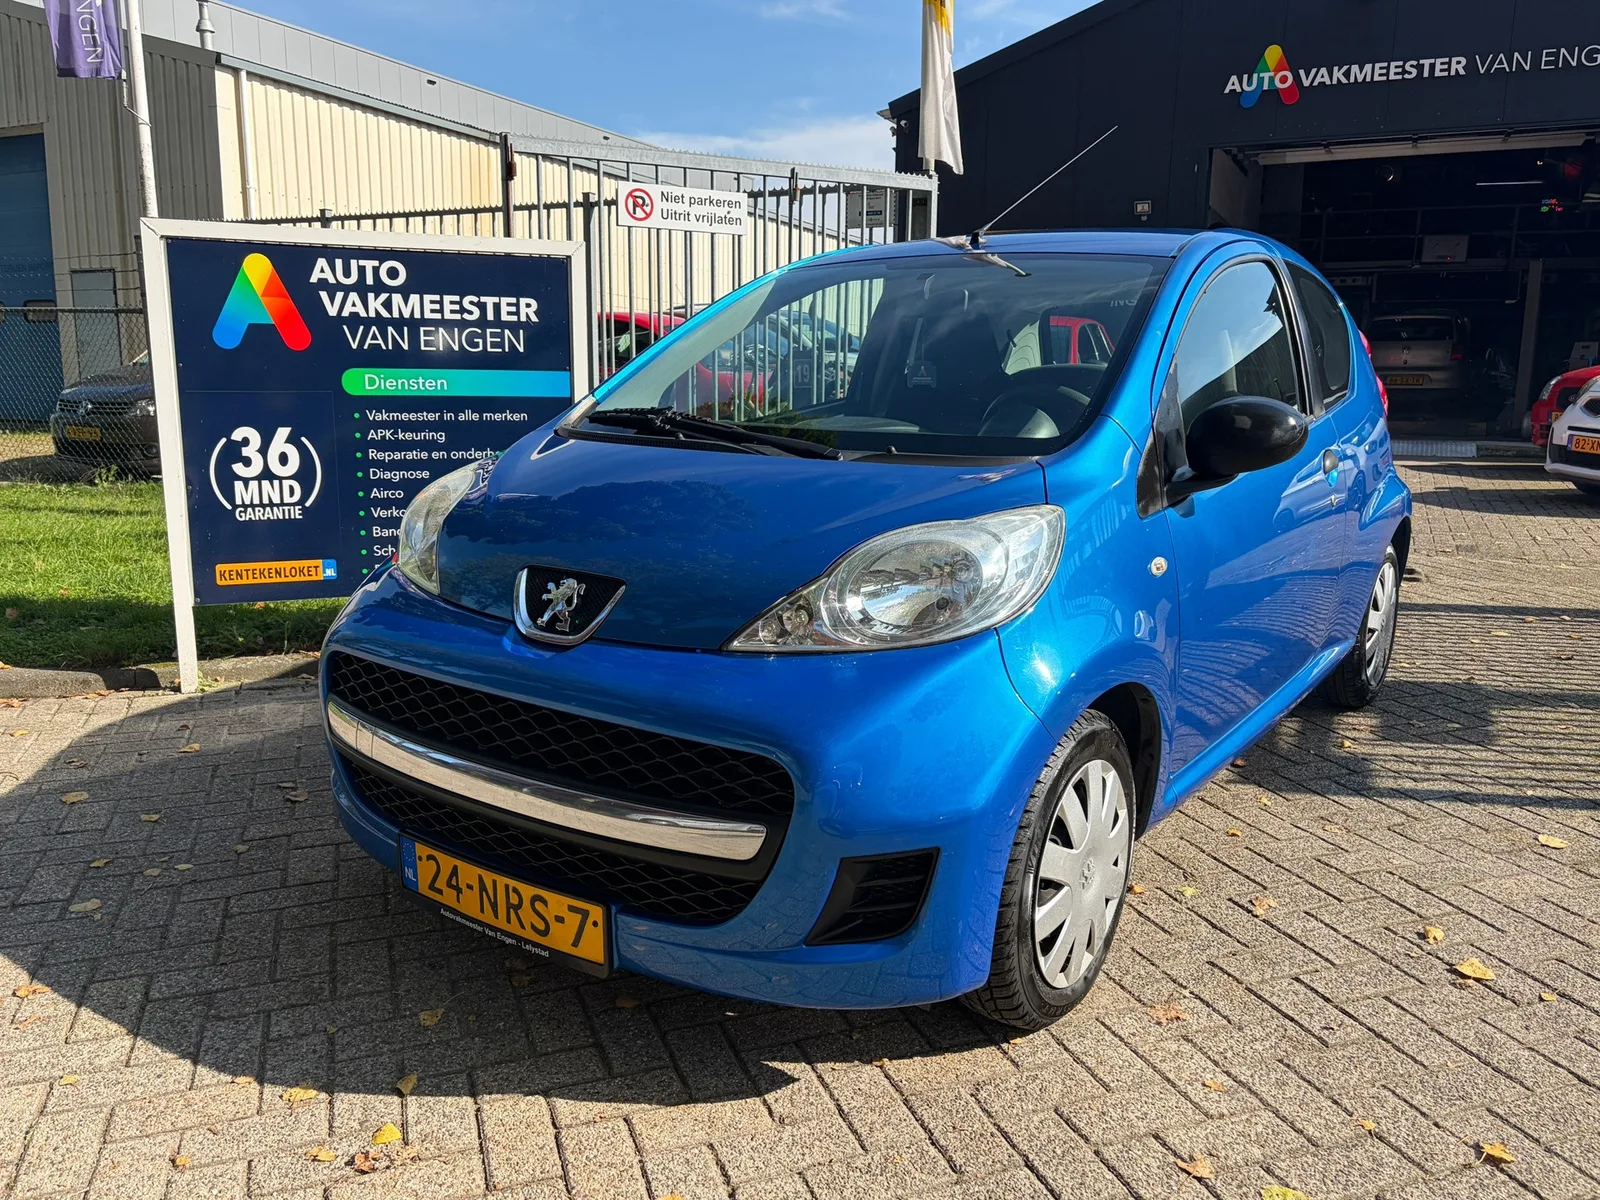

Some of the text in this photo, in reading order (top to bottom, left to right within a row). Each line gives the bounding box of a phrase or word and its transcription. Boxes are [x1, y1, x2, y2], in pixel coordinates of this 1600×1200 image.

[1224, 71, 1293, 94] AUTO
[1298, 56, 1467, 87] VAKMEESTER
[1475, 51, 1532, 75] VAN
[660, 190, 742, 211] Niet parkeren
[660, 207, 742, 227] Uitrit vrijlaten
[309, 257, 407, 287] AUTO
[318, 290, 539, 323] VAKMEESTER
[342, 324, 525, 353] VAN ENGEN
[364, 373, 448, 391] Diensten
[365, 409, 528, 421] Vakmeester in alle merken
[367, 429, 446, 443] APK-keuring
[230, 426, 301, 478] 36
[368, 448, 500, 462] Reparatie en onderh
[369, 468, 430, 482] Diagnose
[233, 479, 302, 505] MND
[370, 487, 404, 499] Airco
[235, 506, 303, 521] GARANTIE
[219, 565, 320, 581] KENTEKENLOKET
[404, 866, 417, 882] NL
[426, 854, 590, 949] 24-NRS-7
[440, 908, 484, 933] Autovakmeester
[484, 926, 496, 938] Van
[496, 932, 517, 946] Engen
[521, 941, 549, 957] Lelystad
